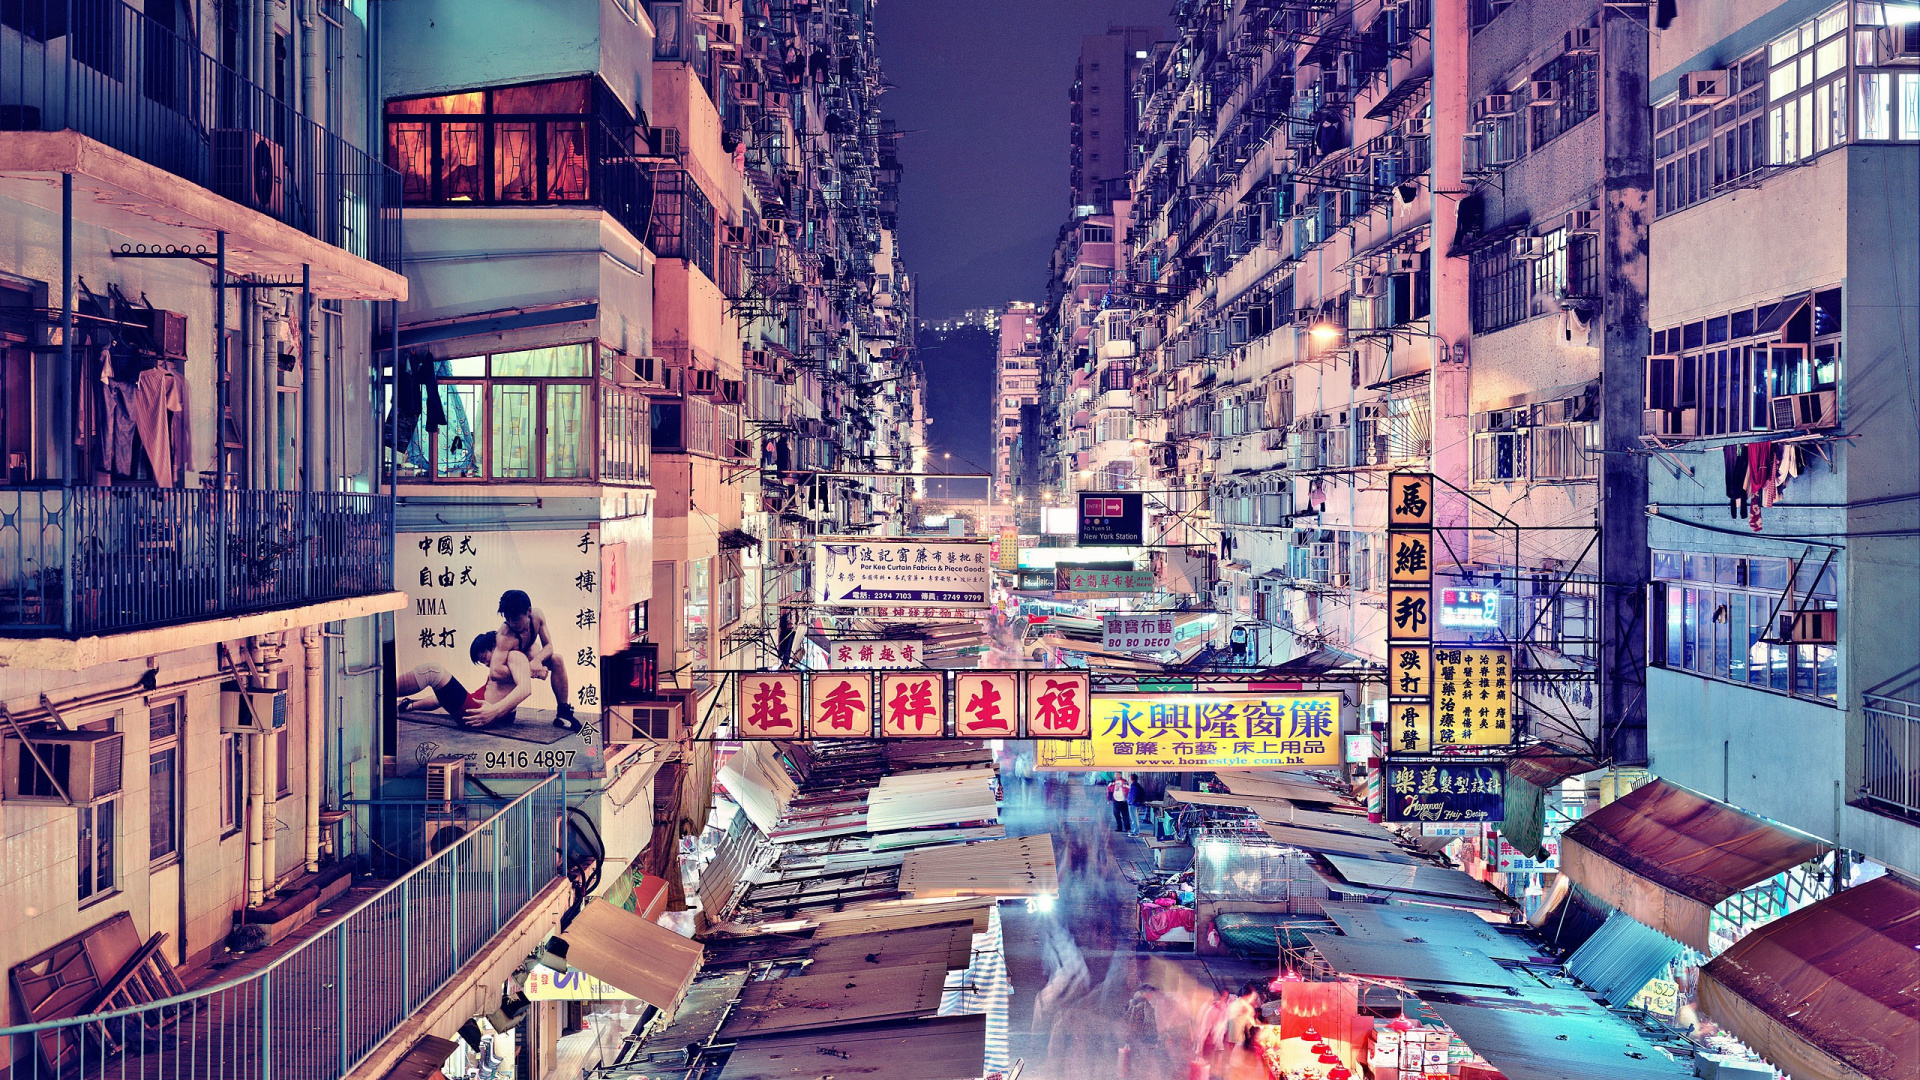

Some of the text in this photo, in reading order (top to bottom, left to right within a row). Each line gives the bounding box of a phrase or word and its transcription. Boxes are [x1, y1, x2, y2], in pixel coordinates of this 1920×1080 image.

[1115, 532, 1138, 540] Station
[418, 535, 477, 557] 中國式
[872, 563, 886, 571] Kee
[912, 564, 937, 572] Fabrics
[944, 565, 962, 573] Piece
[963, 565, 986, 573] Goods
[418, 566, 477, 588] 自由式
[873, 592, 893, 600] 2394
[895, 592, 912, 600] 7103
[942, 593, 961, 601] 2749
[963, 594, 982, 602] 9799
[416, 597, 448, 616] MMA
[1107, 618, 1173, 634] 寶寶布藝
[418, 627, 457, 649] 散打
[1107, 638, 1171, 648] BO BO DECO
[484, 750, 529, 769] 9416
[533, 749, 577, 769] 4897
[1443, 807, 1464, 822] Hair
[1464, 809, 1489, 822] Design
